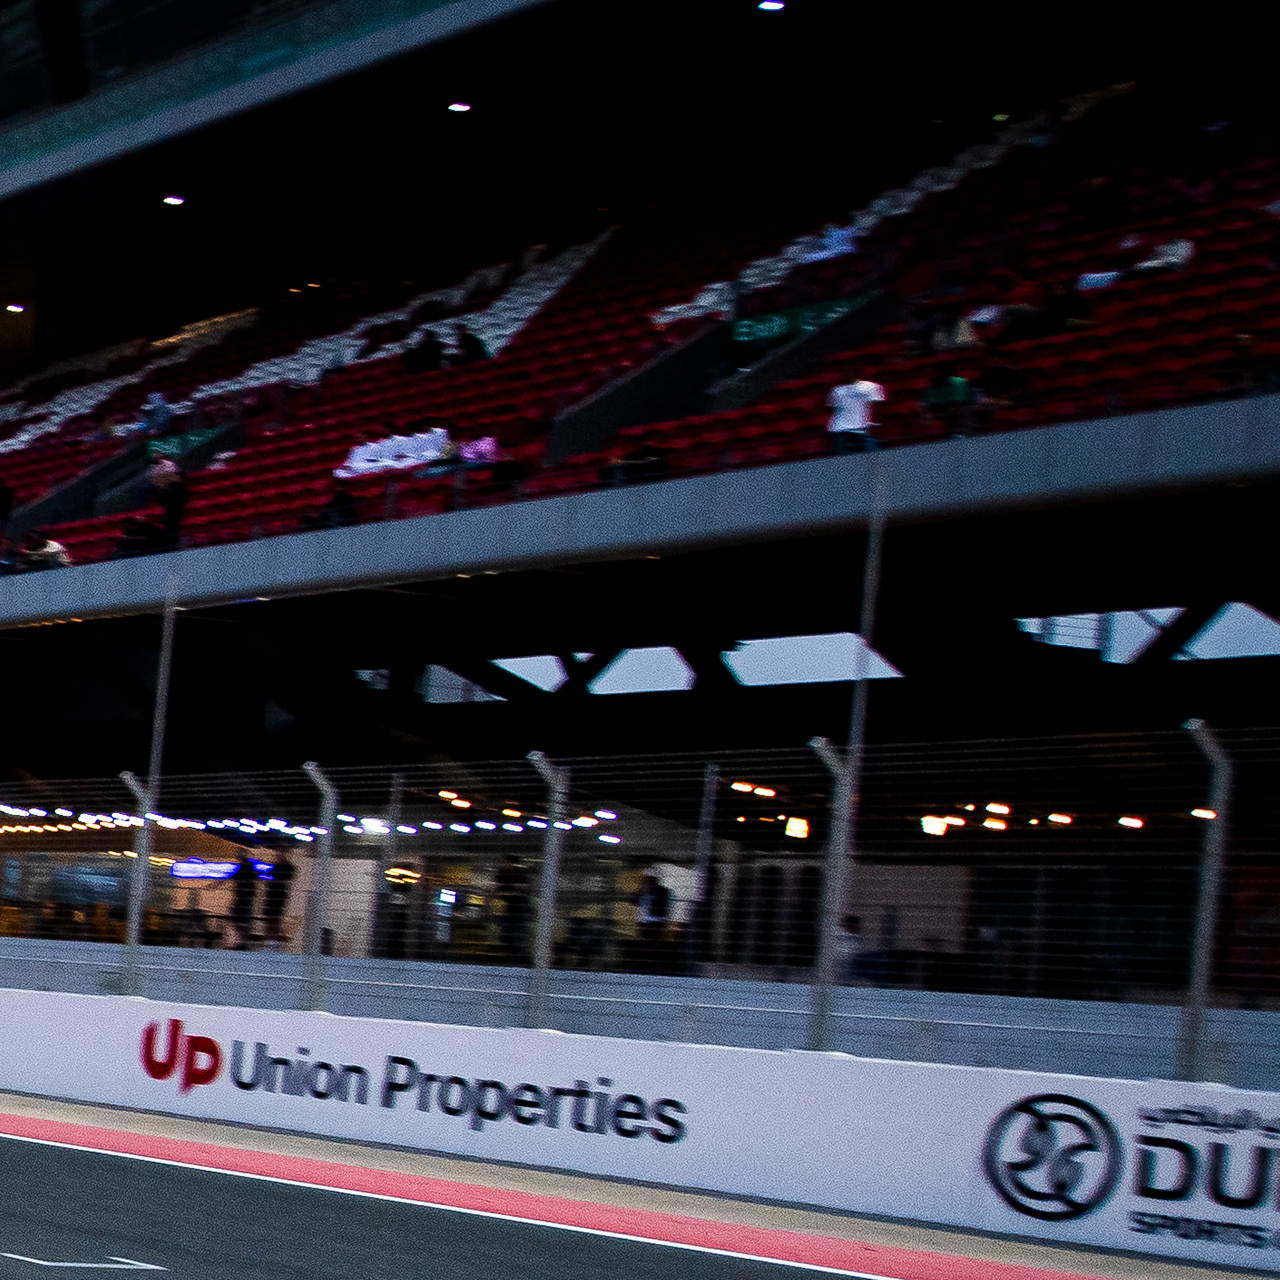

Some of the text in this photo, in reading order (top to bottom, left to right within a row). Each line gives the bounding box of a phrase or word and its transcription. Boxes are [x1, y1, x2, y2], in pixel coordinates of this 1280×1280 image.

[230, 1040, 369, 1104] Union
[380, 1055, 689, 1146] Properties
[1134, 1134, 1280, 1209] DU
